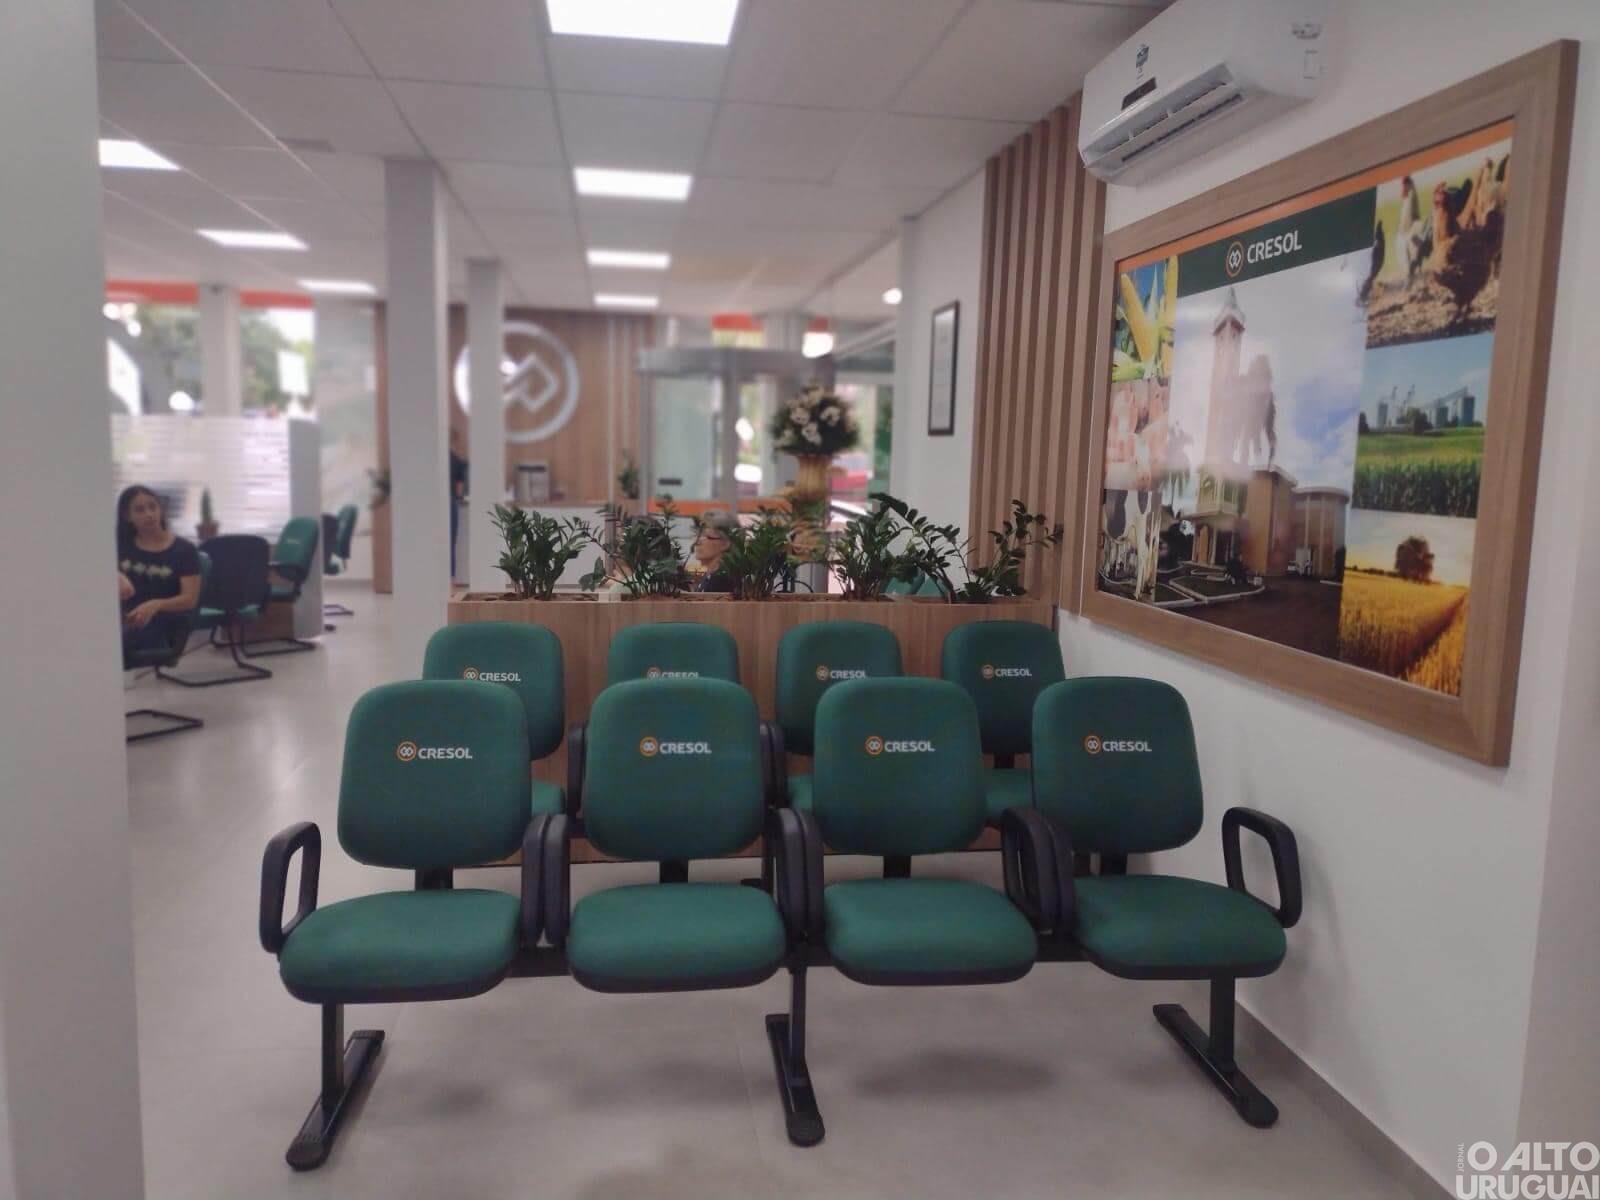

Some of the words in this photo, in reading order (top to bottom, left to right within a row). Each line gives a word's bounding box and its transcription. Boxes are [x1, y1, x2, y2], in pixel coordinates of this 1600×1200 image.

[1247, 230, 1302, 264] CRESOL
[479, 672, 521, 682] CRESOL
[831, 669, 866, 679] CRESOL
[995, 667, 1032, 677] CRESOL
[659, 741, 712, 755] CRESOL
[884, 740, 935, 753] CRESOL
[1102, 740, 1153, 753] CRESOL
[418, 747, 473, 760] CRESOL
